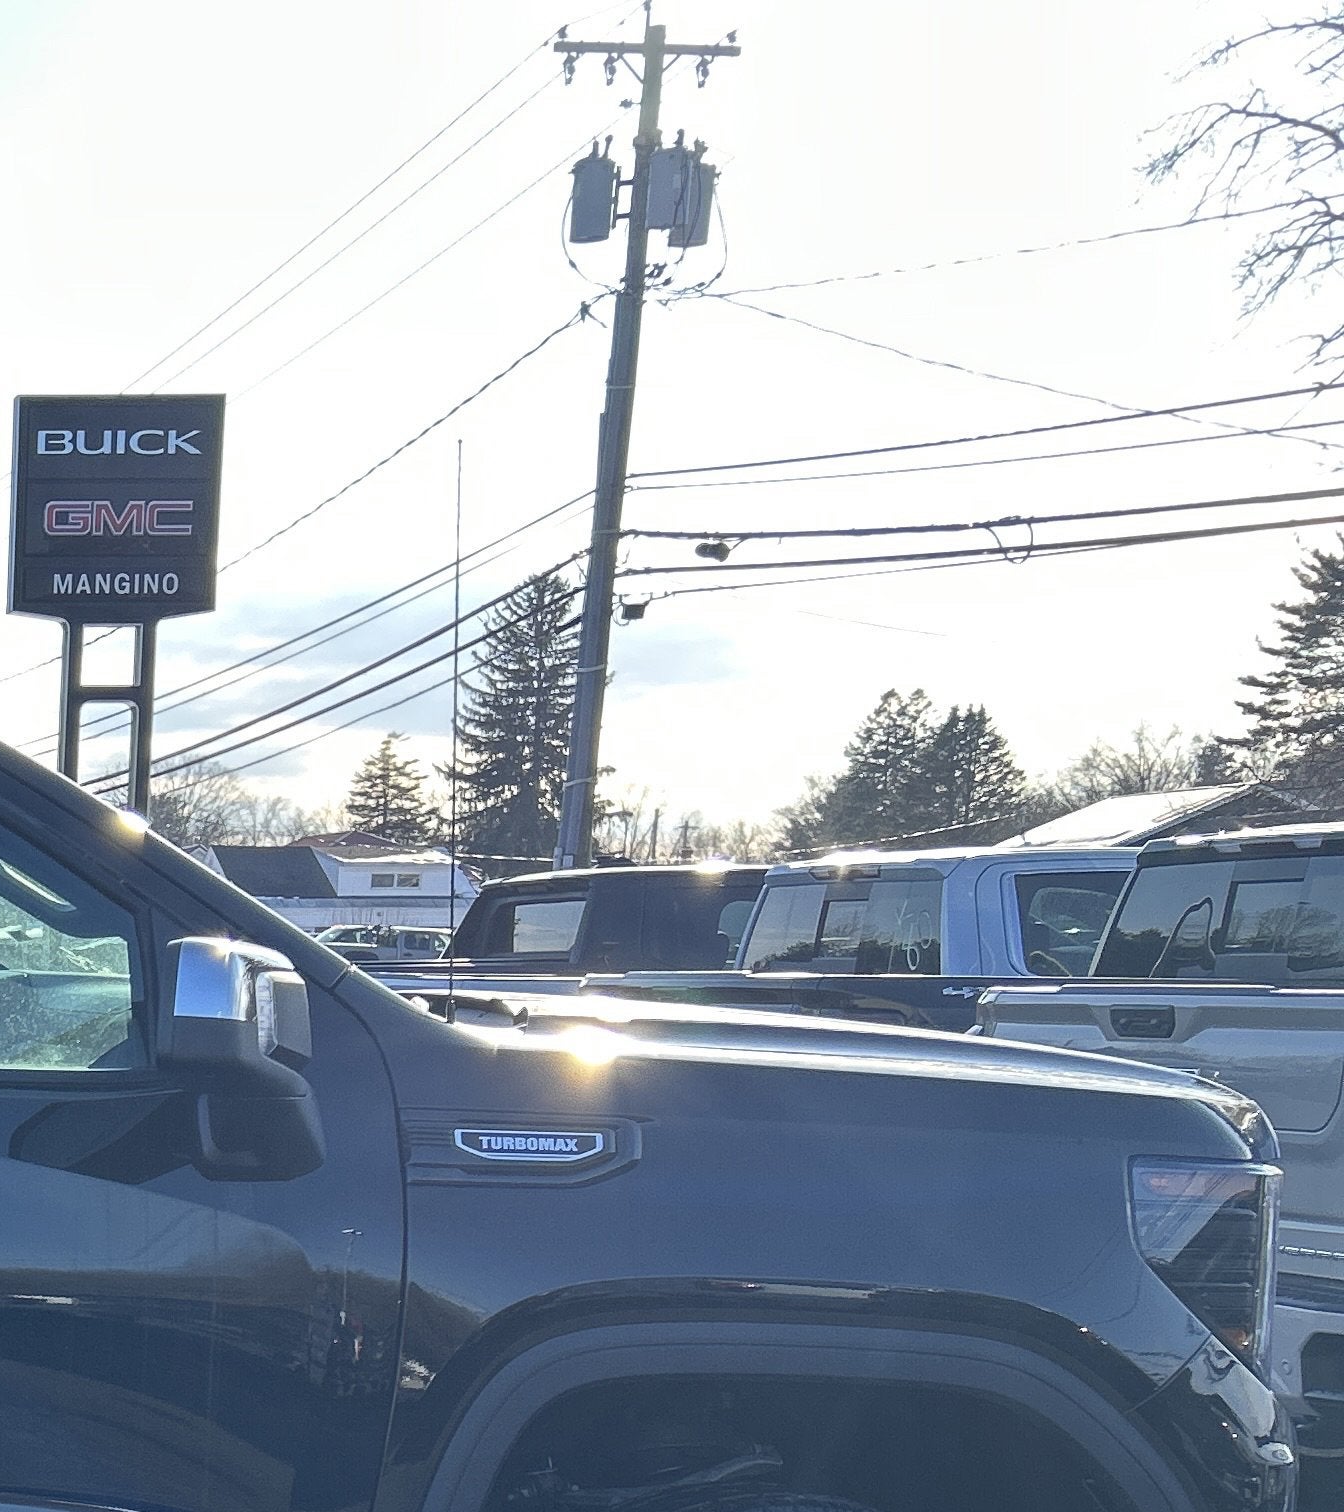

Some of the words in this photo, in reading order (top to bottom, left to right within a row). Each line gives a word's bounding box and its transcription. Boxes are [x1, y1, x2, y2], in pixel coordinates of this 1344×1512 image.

[36, 429, 202, 455] BUICK
[44, 500, 194, 537] GMC
[52, 572, 180, 595] MANGINO
[478, 1135, 579, 1152] TURBOMAX
